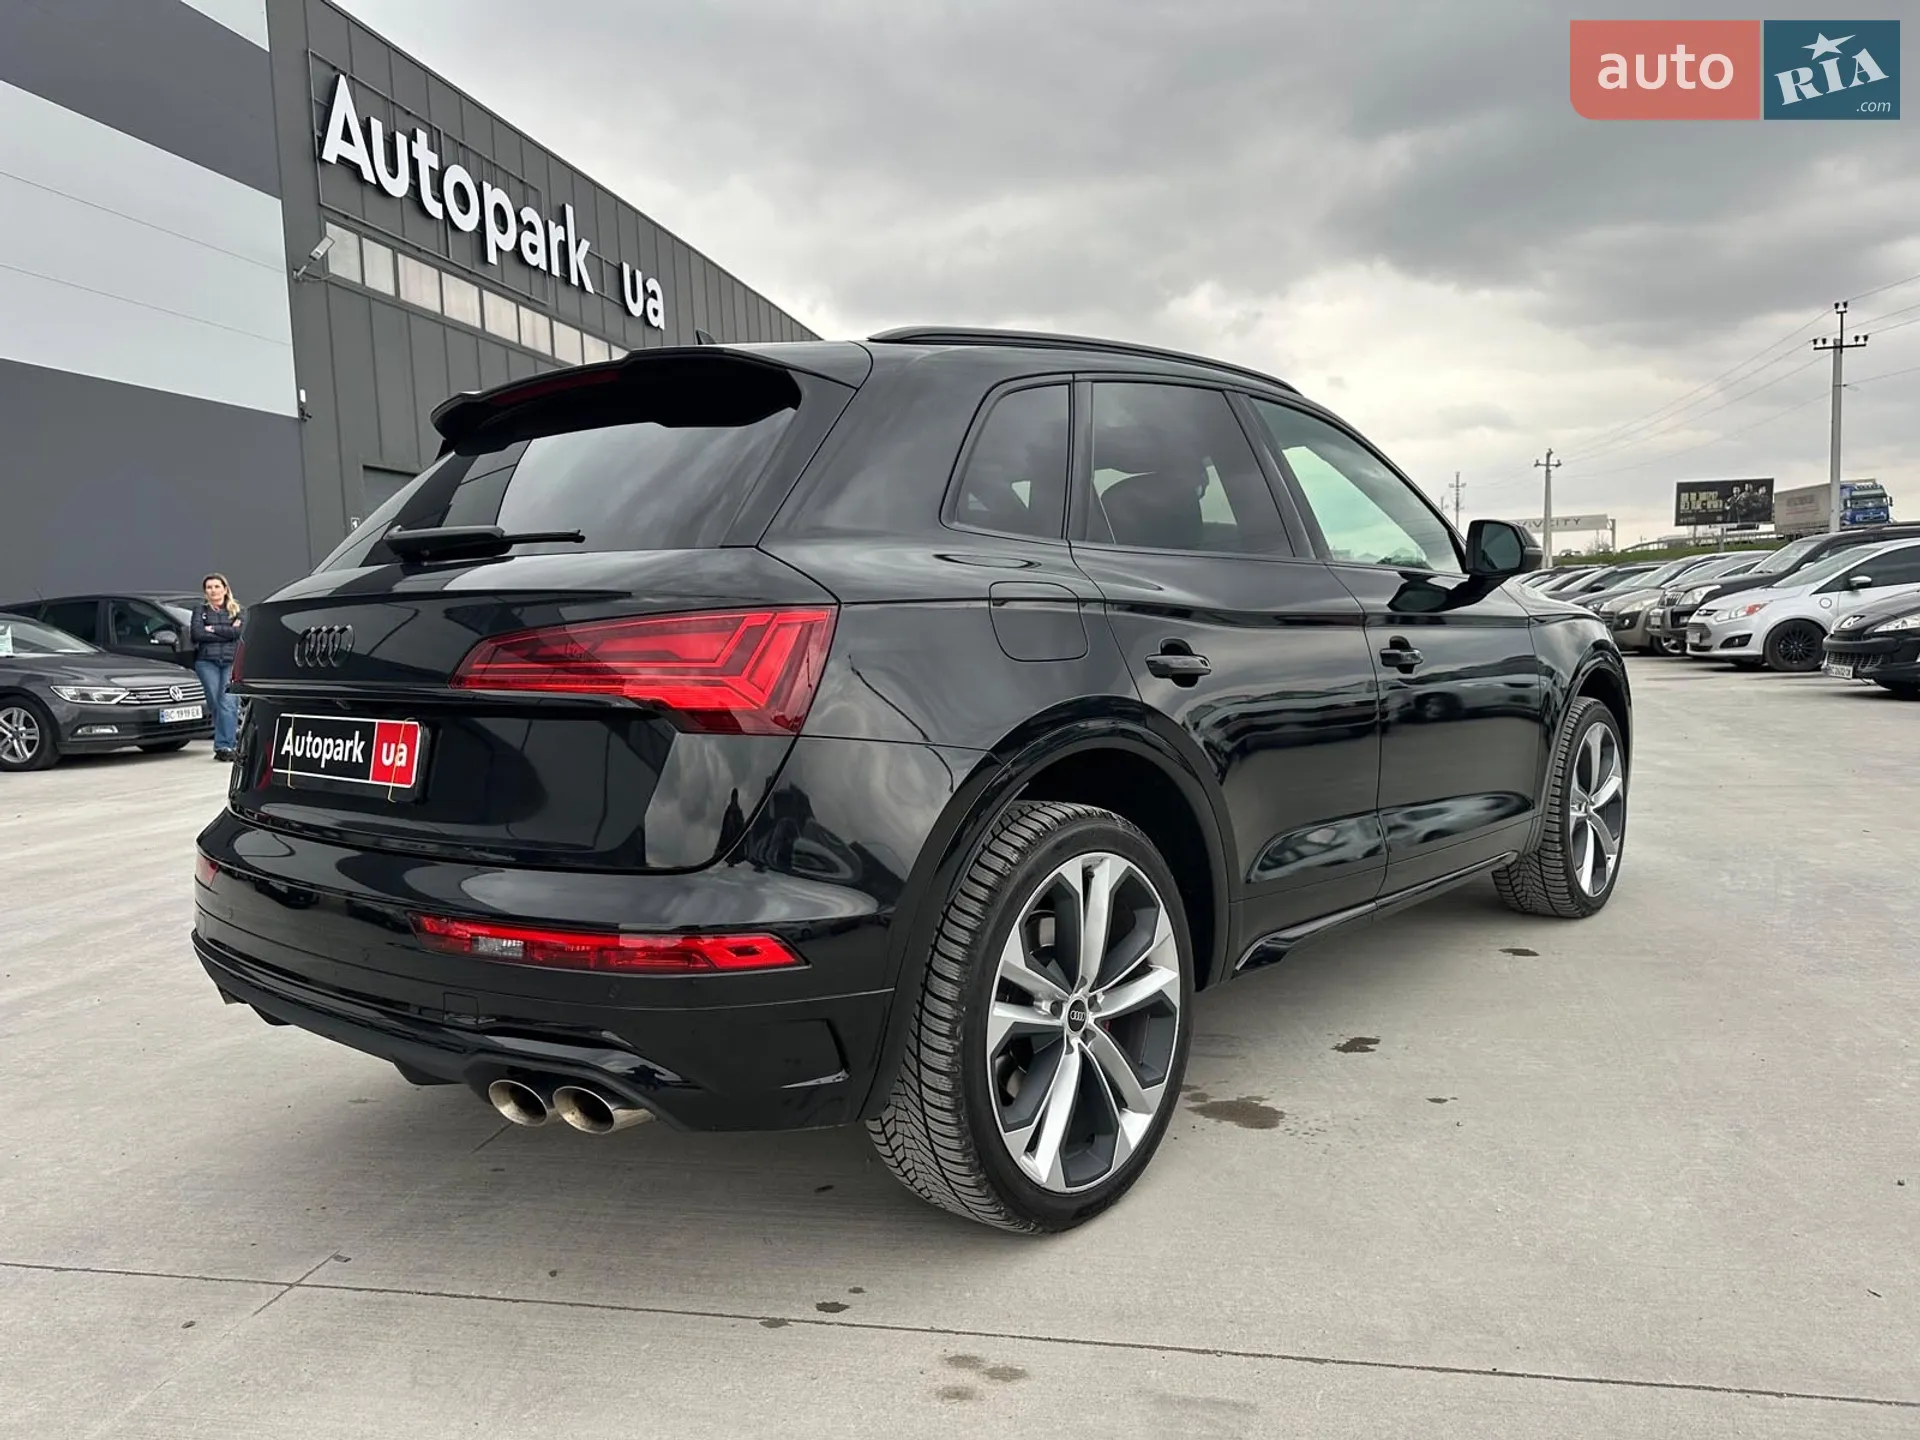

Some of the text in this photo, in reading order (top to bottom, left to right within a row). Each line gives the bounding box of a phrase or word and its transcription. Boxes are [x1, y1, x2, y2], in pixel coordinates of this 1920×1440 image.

[321, 74, 665, 331] Autopark ua
[281, 727, 408, 769] Autopark ua
